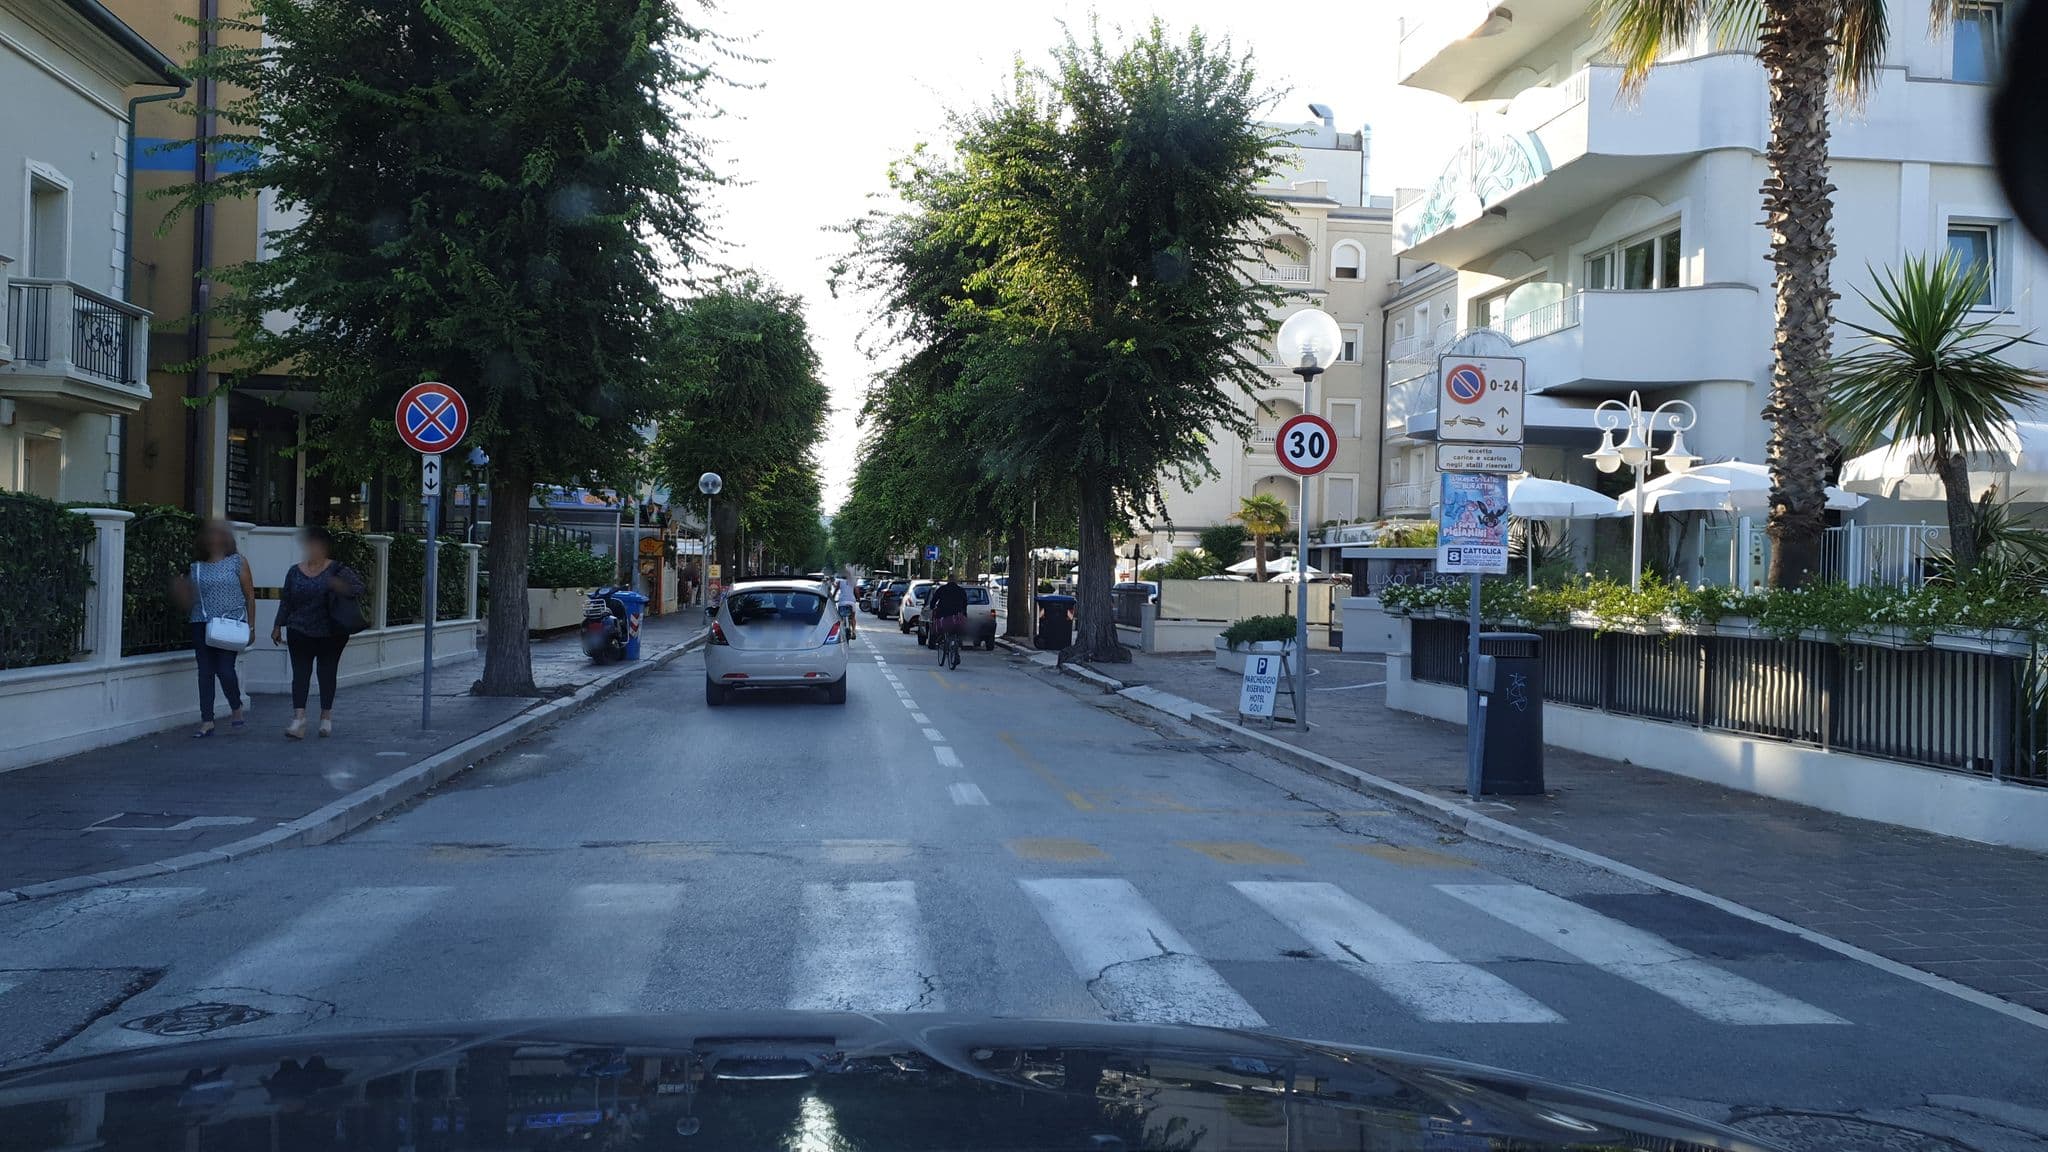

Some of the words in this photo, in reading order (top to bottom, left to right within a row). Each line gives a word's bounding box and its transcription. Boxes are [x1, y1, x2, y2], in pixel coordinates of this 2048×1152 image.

[1490, 379, 1518, 392] 0-24
[1290, 431, 1325, 459] 30
[1449, 551, 1460, 562] 8
[1245, 676, 1276, 684] PARCHEGGIO
[1246, 685, 1271, 693] RISERVATO
[1249, 694, 1264, 703] HOTEL
[1249, 704, 1263, 712] GOLF
